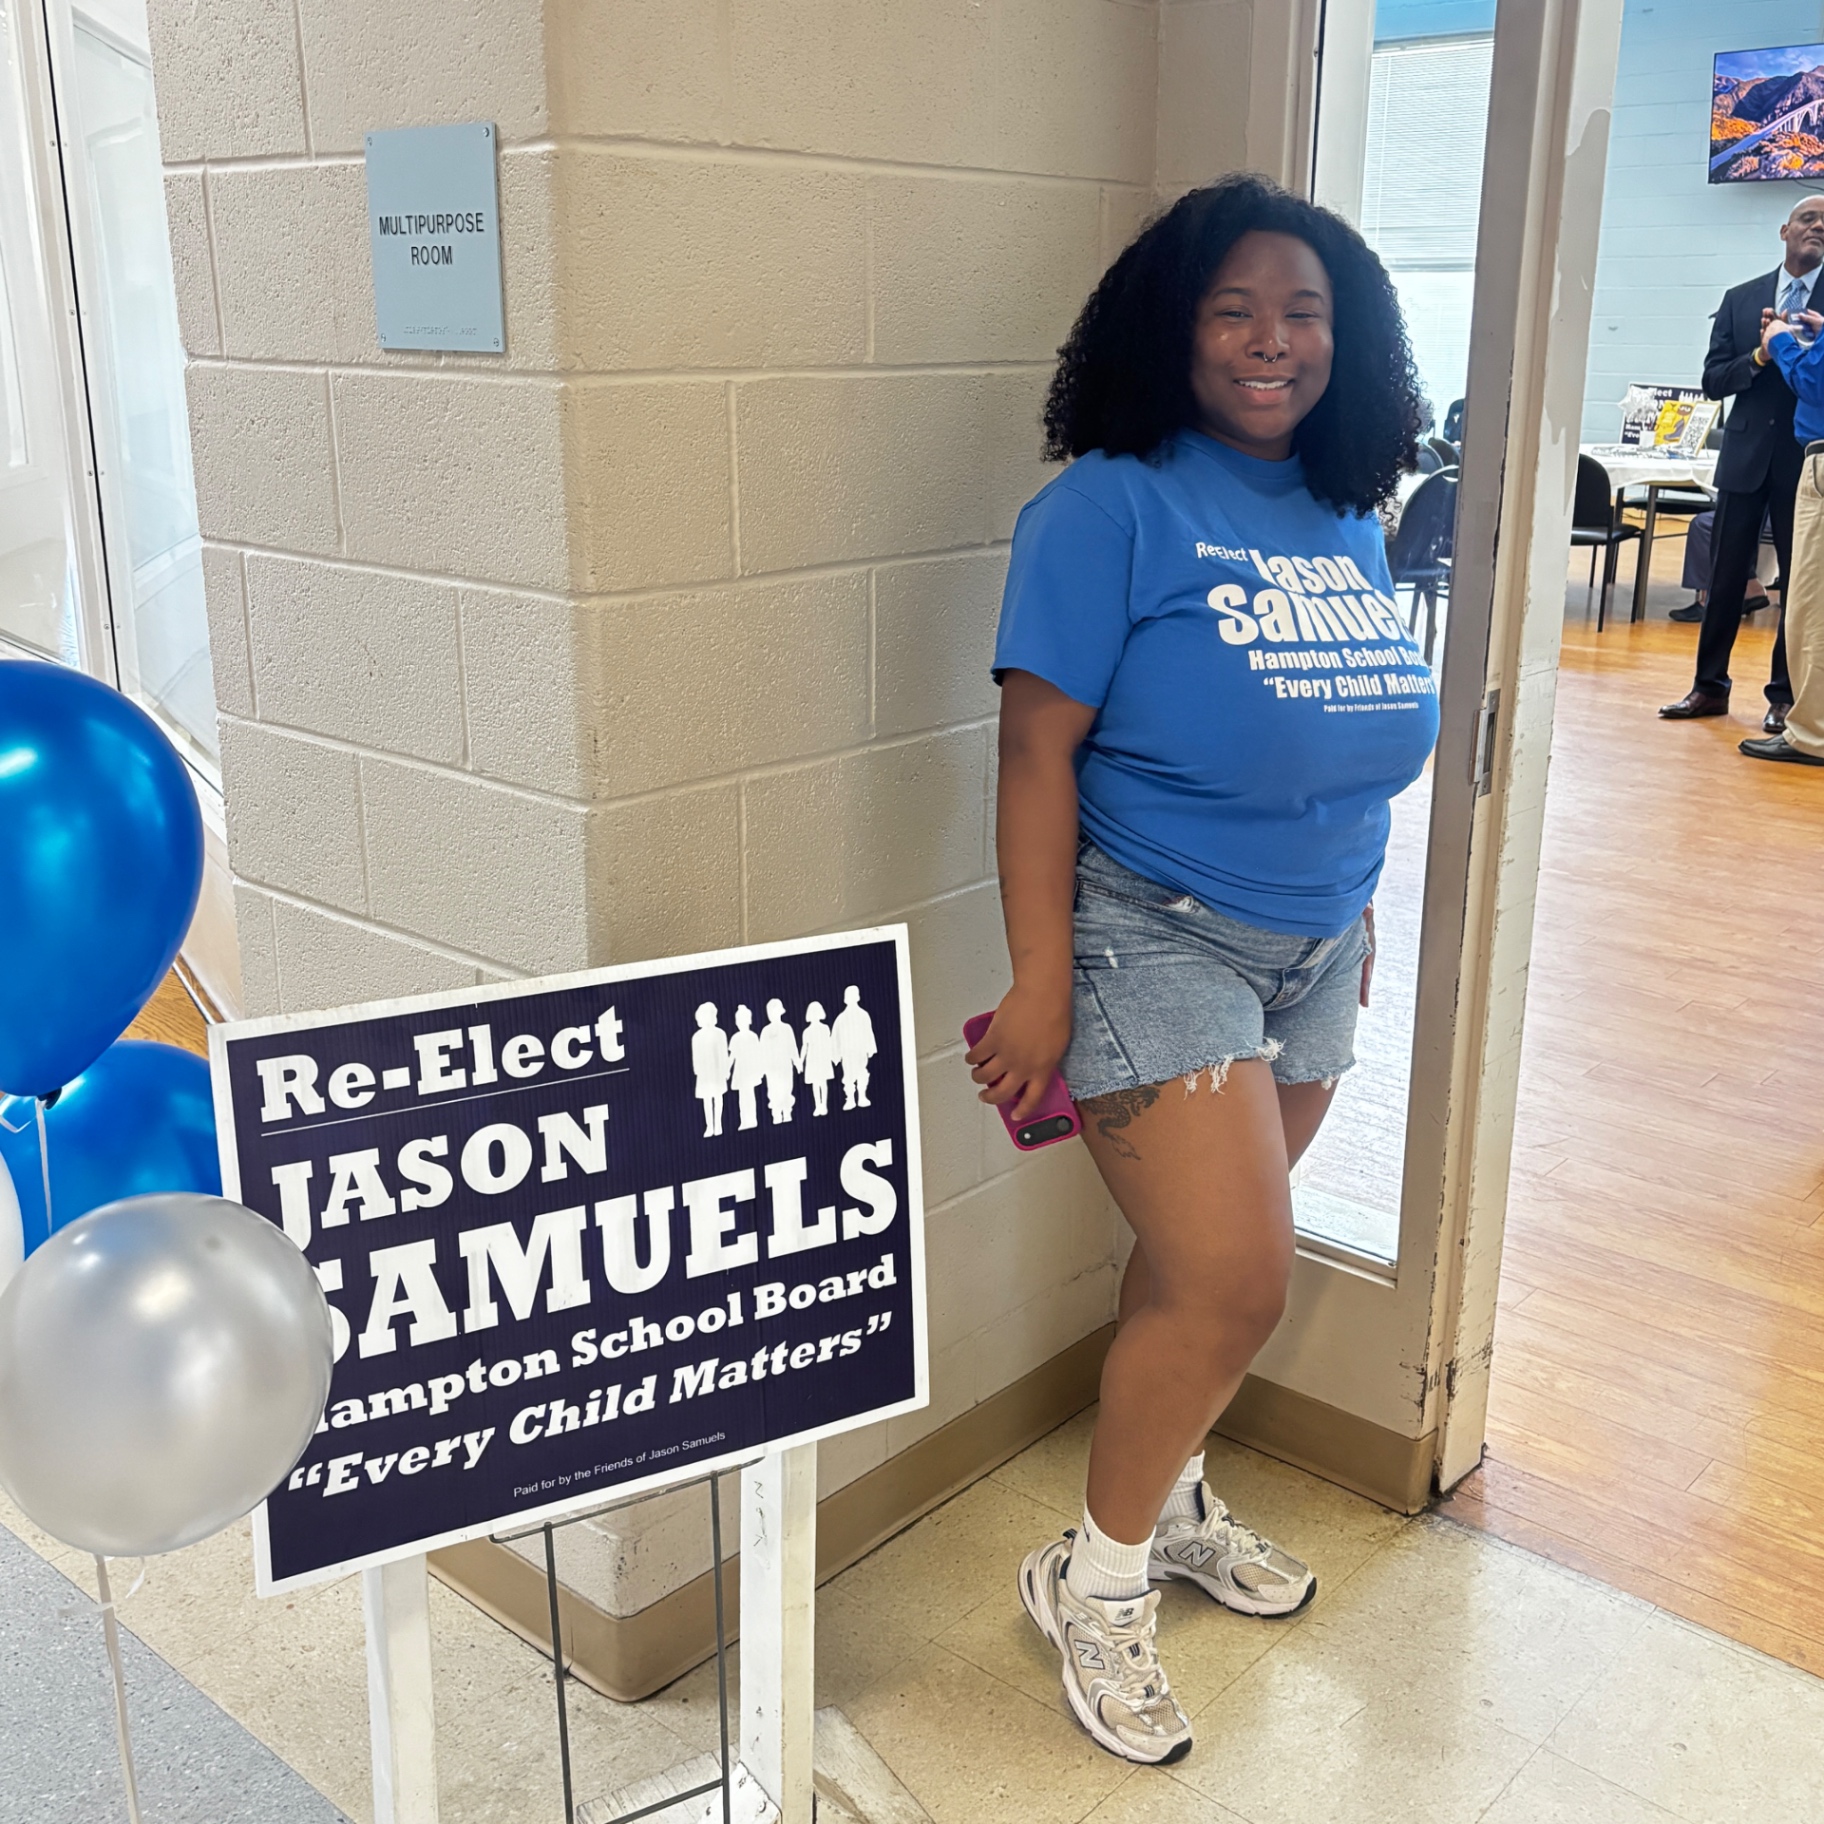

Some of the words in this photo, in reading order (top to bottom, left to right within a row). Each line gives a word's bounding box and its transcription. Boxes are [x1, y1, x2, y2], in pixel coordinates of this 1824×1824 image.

[379, 212, 485, 235] MULTIPURPOSE
[411, 246, 453, 265] ROOM
[1207, 583, 1417, 645] Samuel
[1248, 650, 1343, 671] Hampton
[1341, 646, 1403, 668] School
[1263, 676, 1333, 700] “Every
[1335, 674, 1383, 698] Child
[256, 1005, 626, 1123] Re-Elect
[271, 1104, 610, 1253] JASON
[314, 1350, 561, 1434] ampton
[571, 1291, 744, 1368] School
[753, 1252, 897, 1321] Board
[288, 1426, 497, 1498] “Every
[509, 1374, 658, 1445] Child
[668, 1310, 893, 1404] Matters”
[513, 1481, 539, 1498] Paid
[541, 1478, 556, 1490] for
[558, 1473, 572, 1486] by
[574, 1470, 592, 1481] the
[593, 1456, 634, 1476] Friends
[636, 1453, 647, 1464] of
[649, 1444, 680, 1460] Jason
[682, 1430, 726, 1452] Samuels
